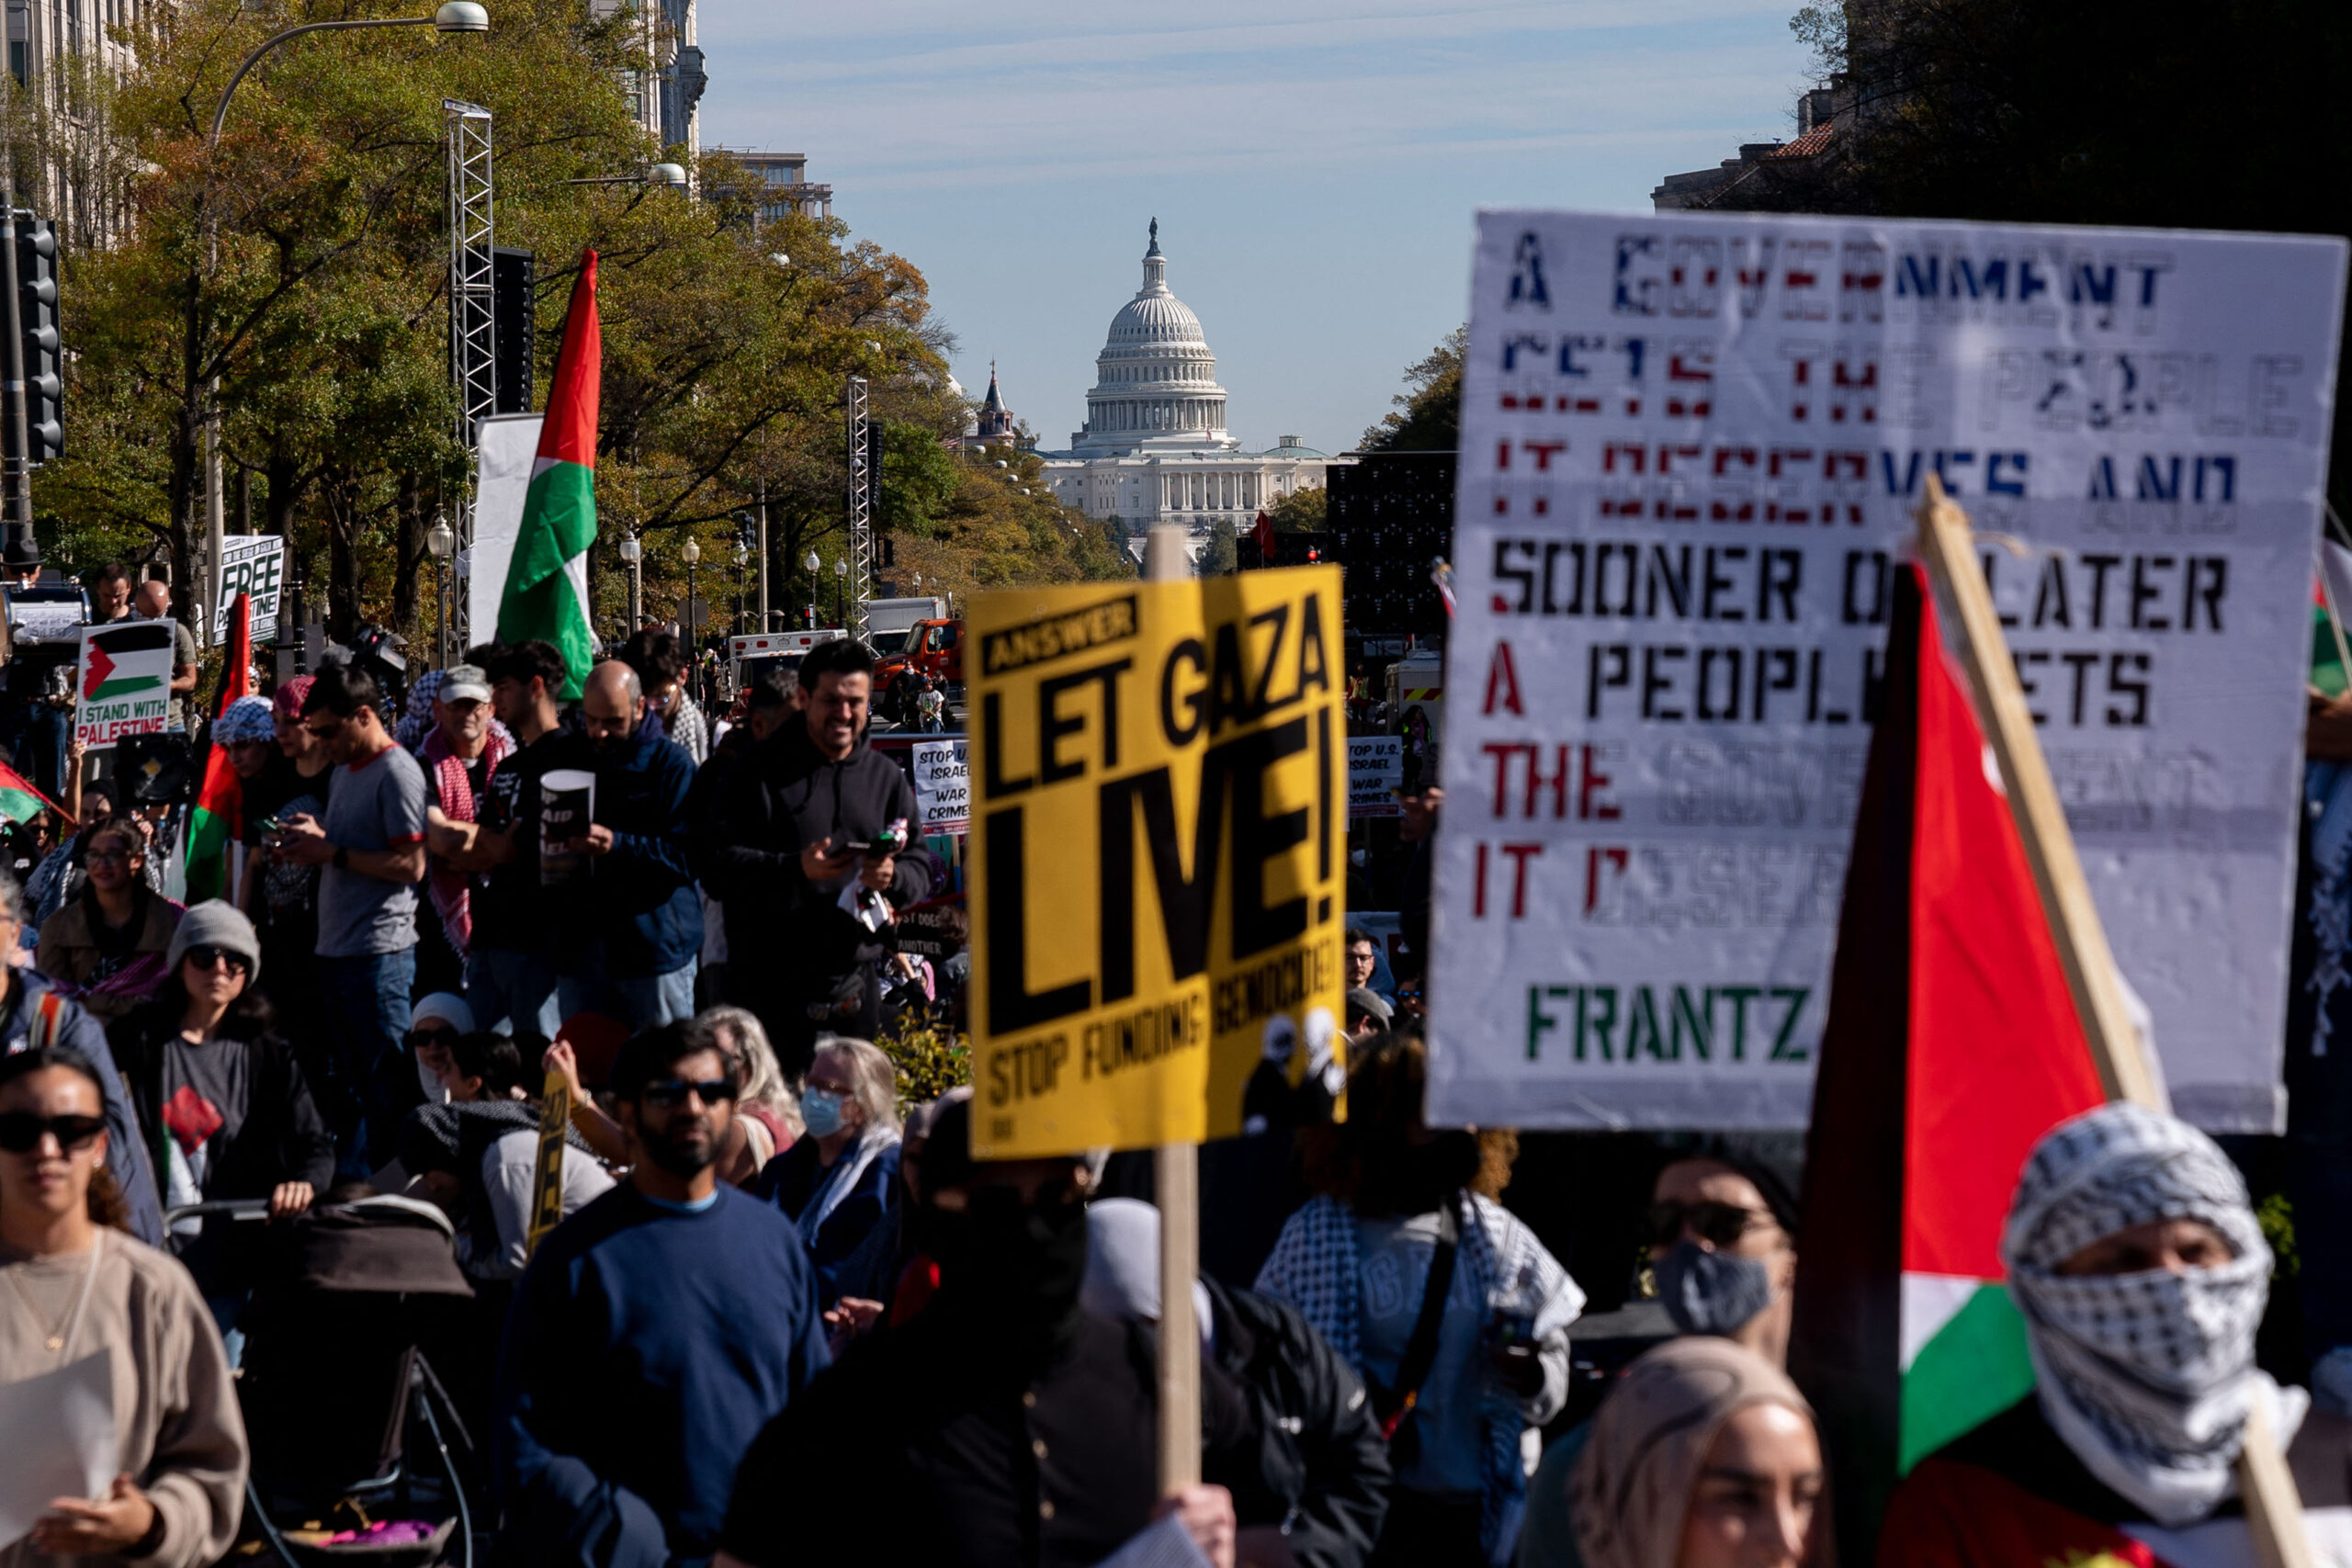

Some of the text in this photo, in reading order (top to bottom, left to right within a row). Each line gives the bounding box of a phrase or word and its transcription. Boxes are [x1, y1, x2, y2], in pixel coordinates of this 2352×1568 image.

[1503, 231, 2176, 336] A GOVERNMENT
[1498, 331, 2304, 439] GETS THE PEOPLE
[1492, 438, 2241, 535] IT DESERVES AND
[220, 552, 282, 608] FREE
[1490, 538, 2233, 635] SOONER O LATER
[988, 603, 1136, 670] ANSWER
[78, 699, 167, 724] I STAND WITH
[983, 592, 1329, 799] LET GAZA
[1481, 639, 1525, 717] A
[2014, 651, 2153, 728] ETS
[77, 716, 165, 746] PALESTINE
[920, 750, 954, 764] STOP
[1349, 745, 1373, 758] TOP
[935, 788, 967, 803] WAR
[1352, 778, 1384, 790] WAR
[1481, 741, 1622, 820] THE
[985, 705, 1332, 1038] LIVE!
[1473, 840, 1544, 919] IT
[897, 938, 942, 955] ANOTHER
[918, 911, 941, 929] DOES
[989, 1031, 1069, 1109] STOP
[1080, 992, 1204, 1084] FUNDING
[1524, 983, 1812, 1063] FRANTZ
